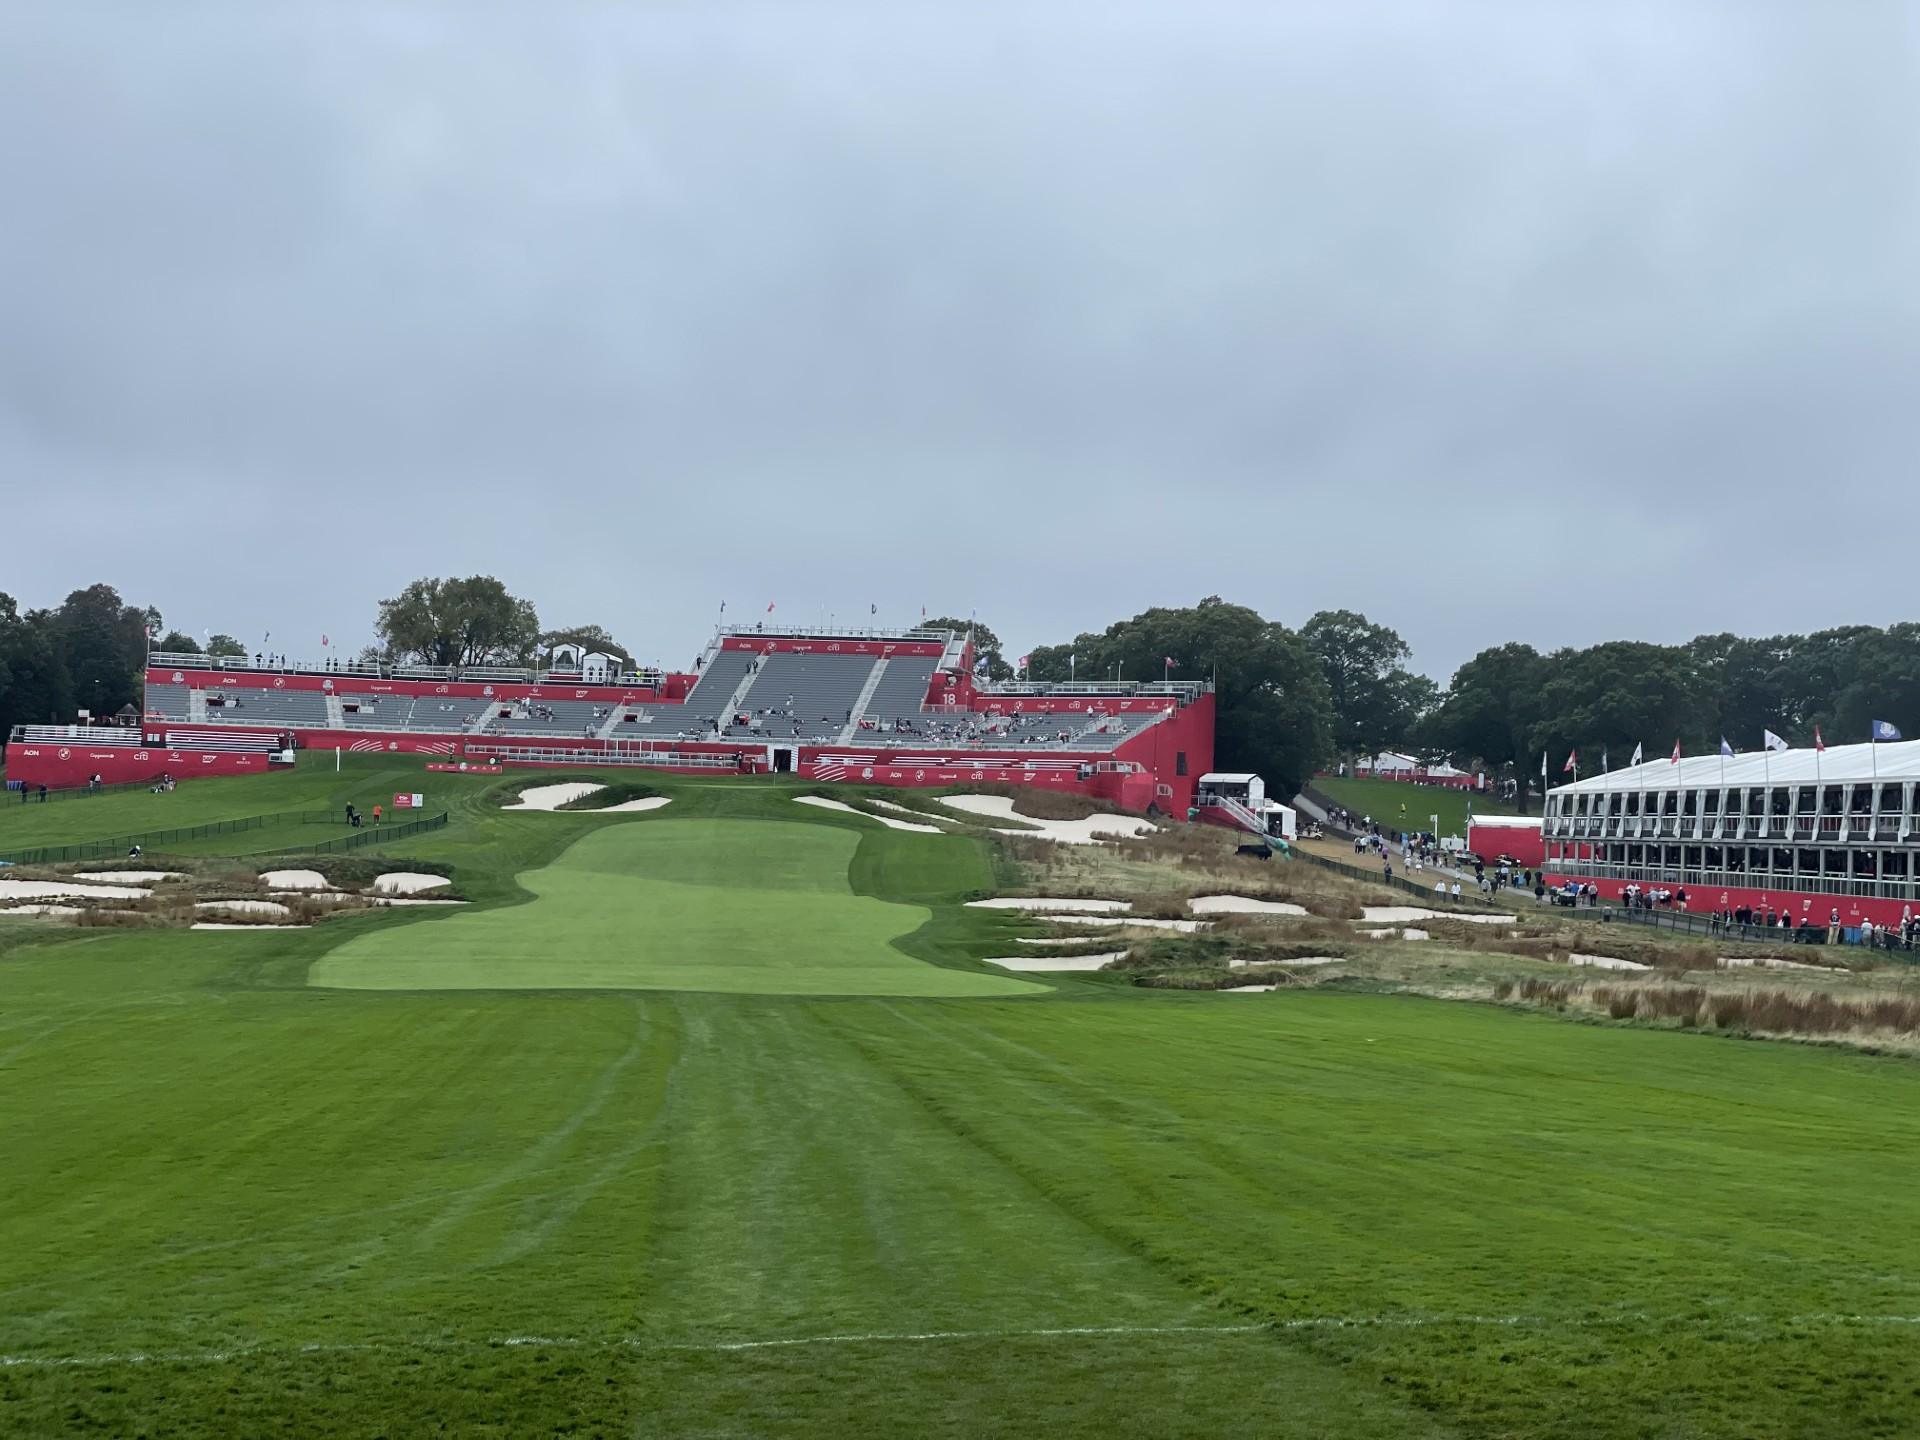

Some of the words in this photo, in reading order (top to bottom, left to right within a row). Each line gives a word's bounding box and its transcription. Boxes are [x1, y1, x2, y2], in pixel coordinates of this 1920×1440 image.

[943, 693, 956, 705] 18
[133, 751, 149, 761] citi
[971, 770, 983, 780] citi
